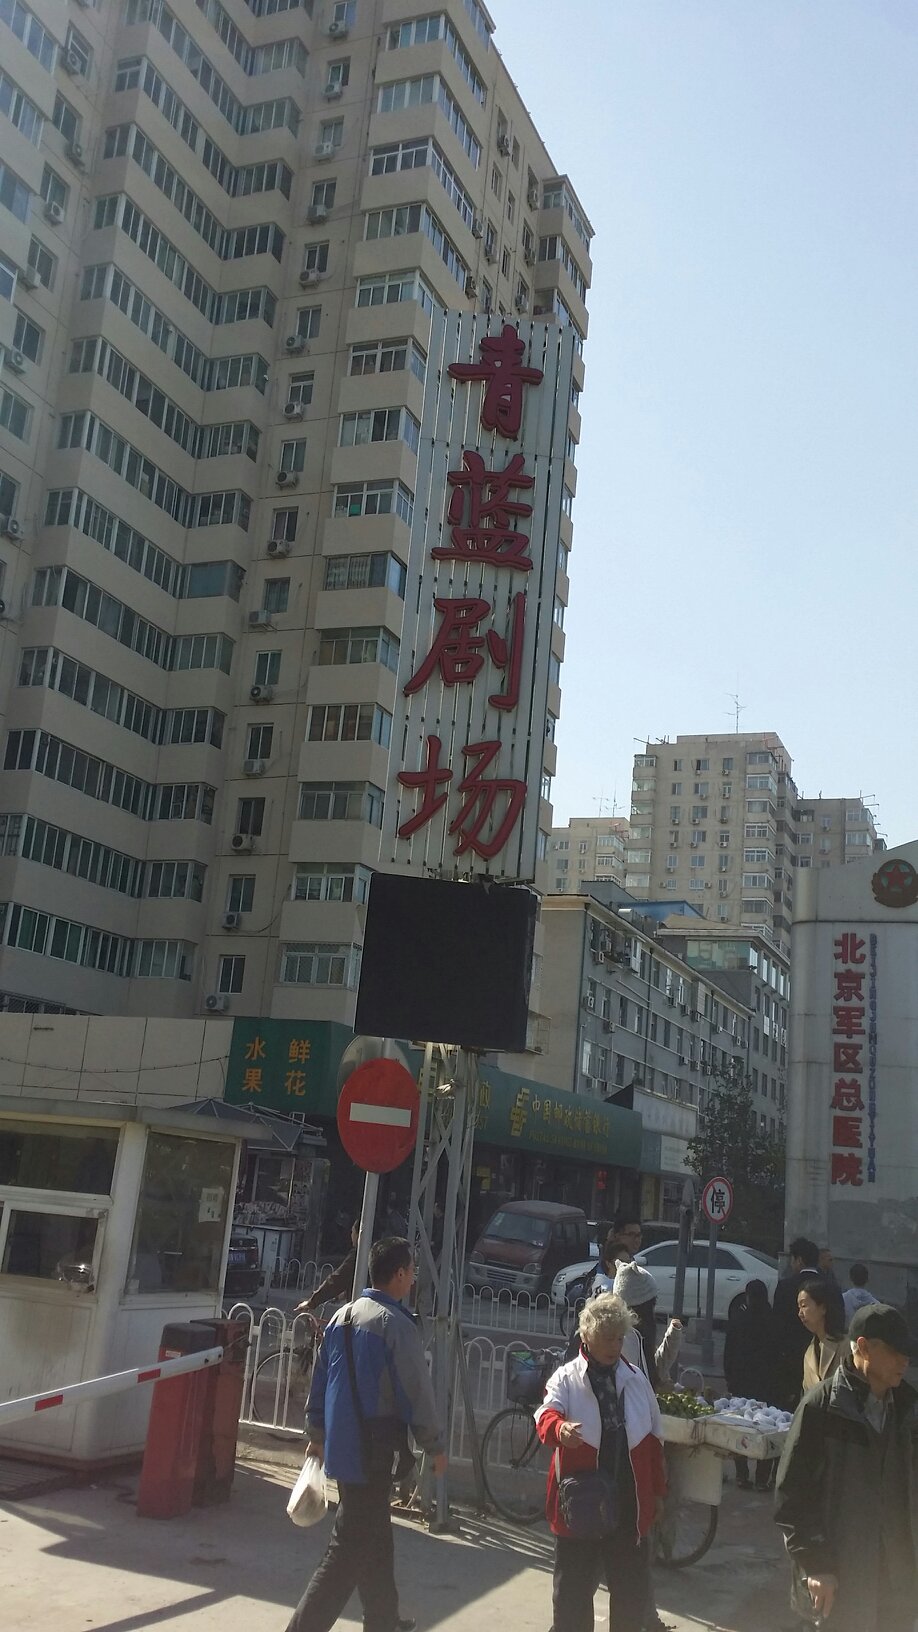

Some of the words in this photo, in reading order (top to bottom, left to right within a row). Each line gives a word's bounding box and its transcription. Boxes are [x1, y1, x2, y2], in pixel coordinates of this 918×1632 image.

[396, 324, 545, 860] 青蓝剧场
[242, 1036, 266, 1092] 水果
[285, 1038, 311, 1096] 鲜花
[830, 932, 866, 1187] 北京军区总医院
[711, 1188, 726, 1214] 停
